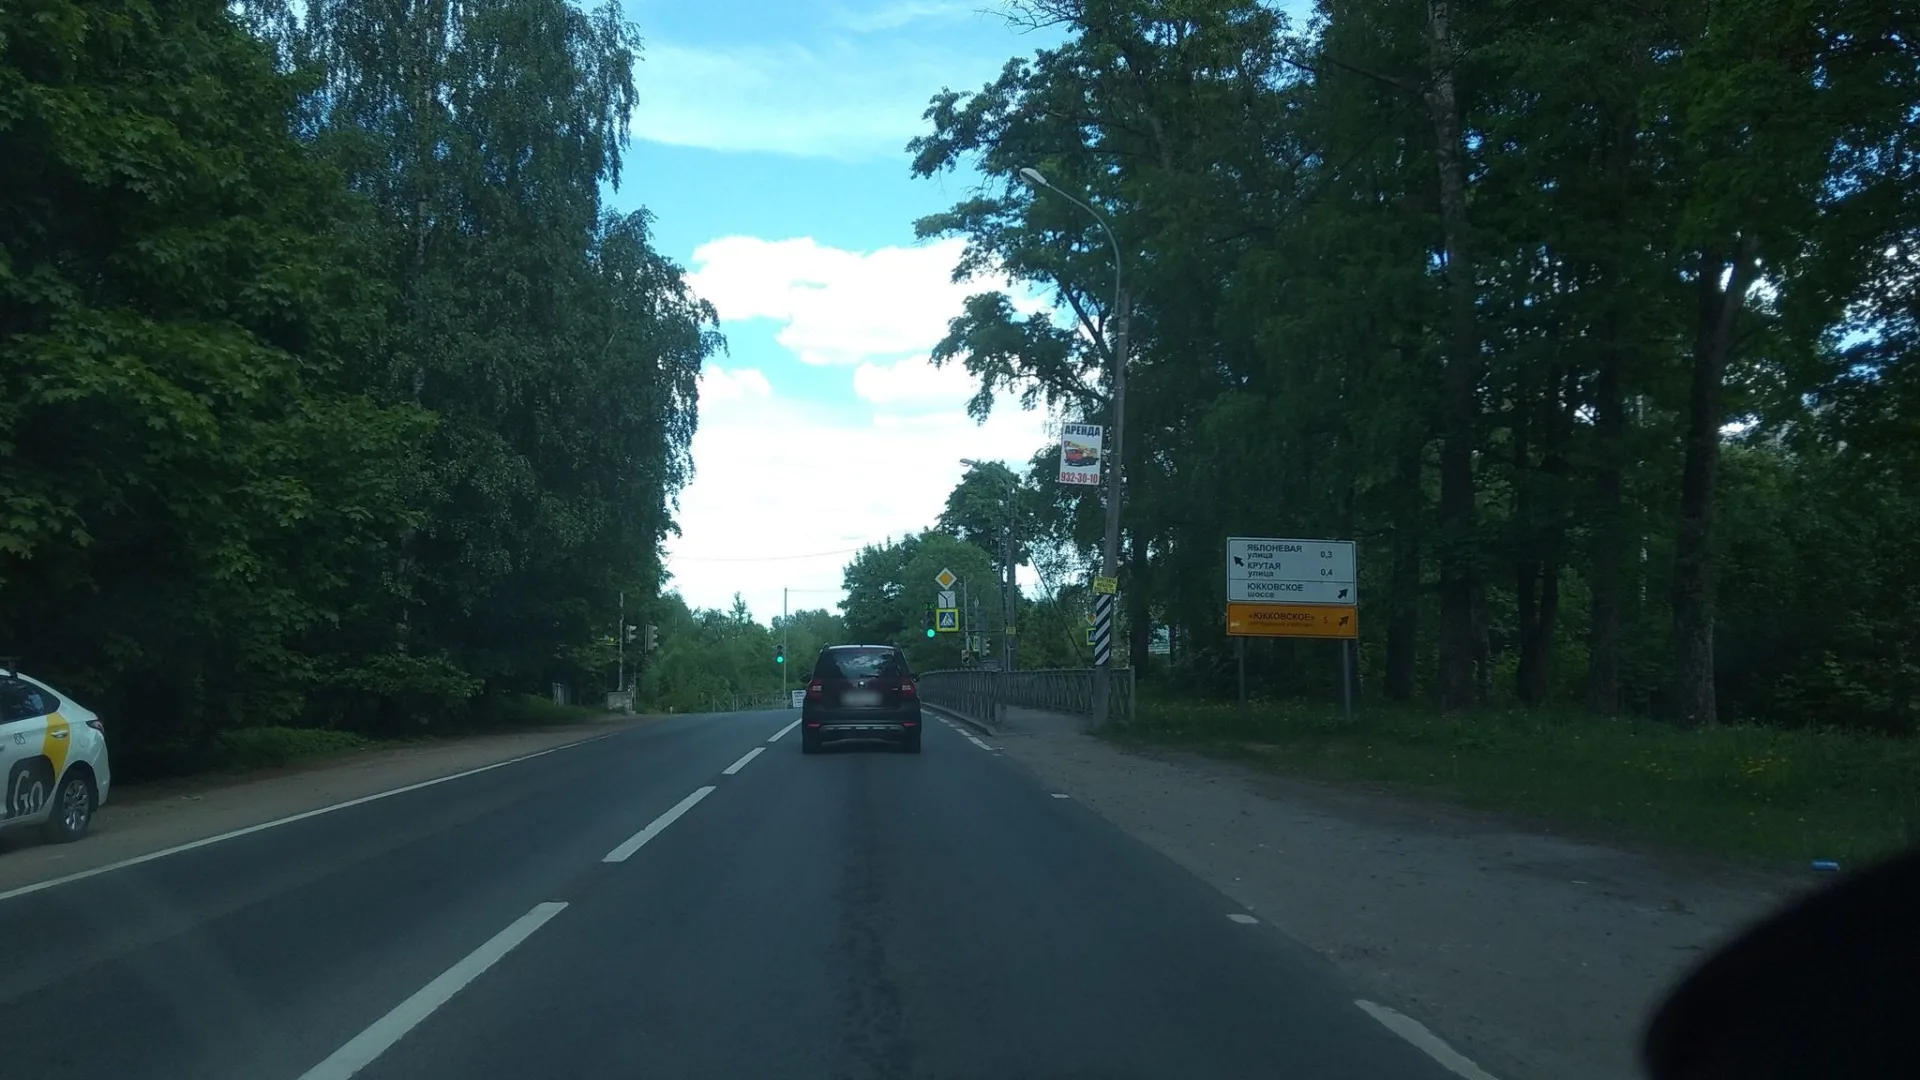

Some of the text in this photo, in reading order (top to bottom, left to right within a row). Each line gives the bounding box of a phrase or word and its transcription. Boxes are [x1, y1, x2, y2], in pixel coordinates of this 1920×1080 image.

[1065, 425, 1100, 437] АРЕНДА
[1247, 544, 1302, 553] ЯБЛОНЕВАЯ
[1320, 551, 1333, 559] 0,3
[1247, 562, 1281, 570] КРУТАЯ
[1247, 570, 1274, 578] улица
[1320, 569, 1333, 577] 0,4
[1247, 583, 1304, 592] ЮККОВСКОЕ
[13, 770, 43, 815] Go
